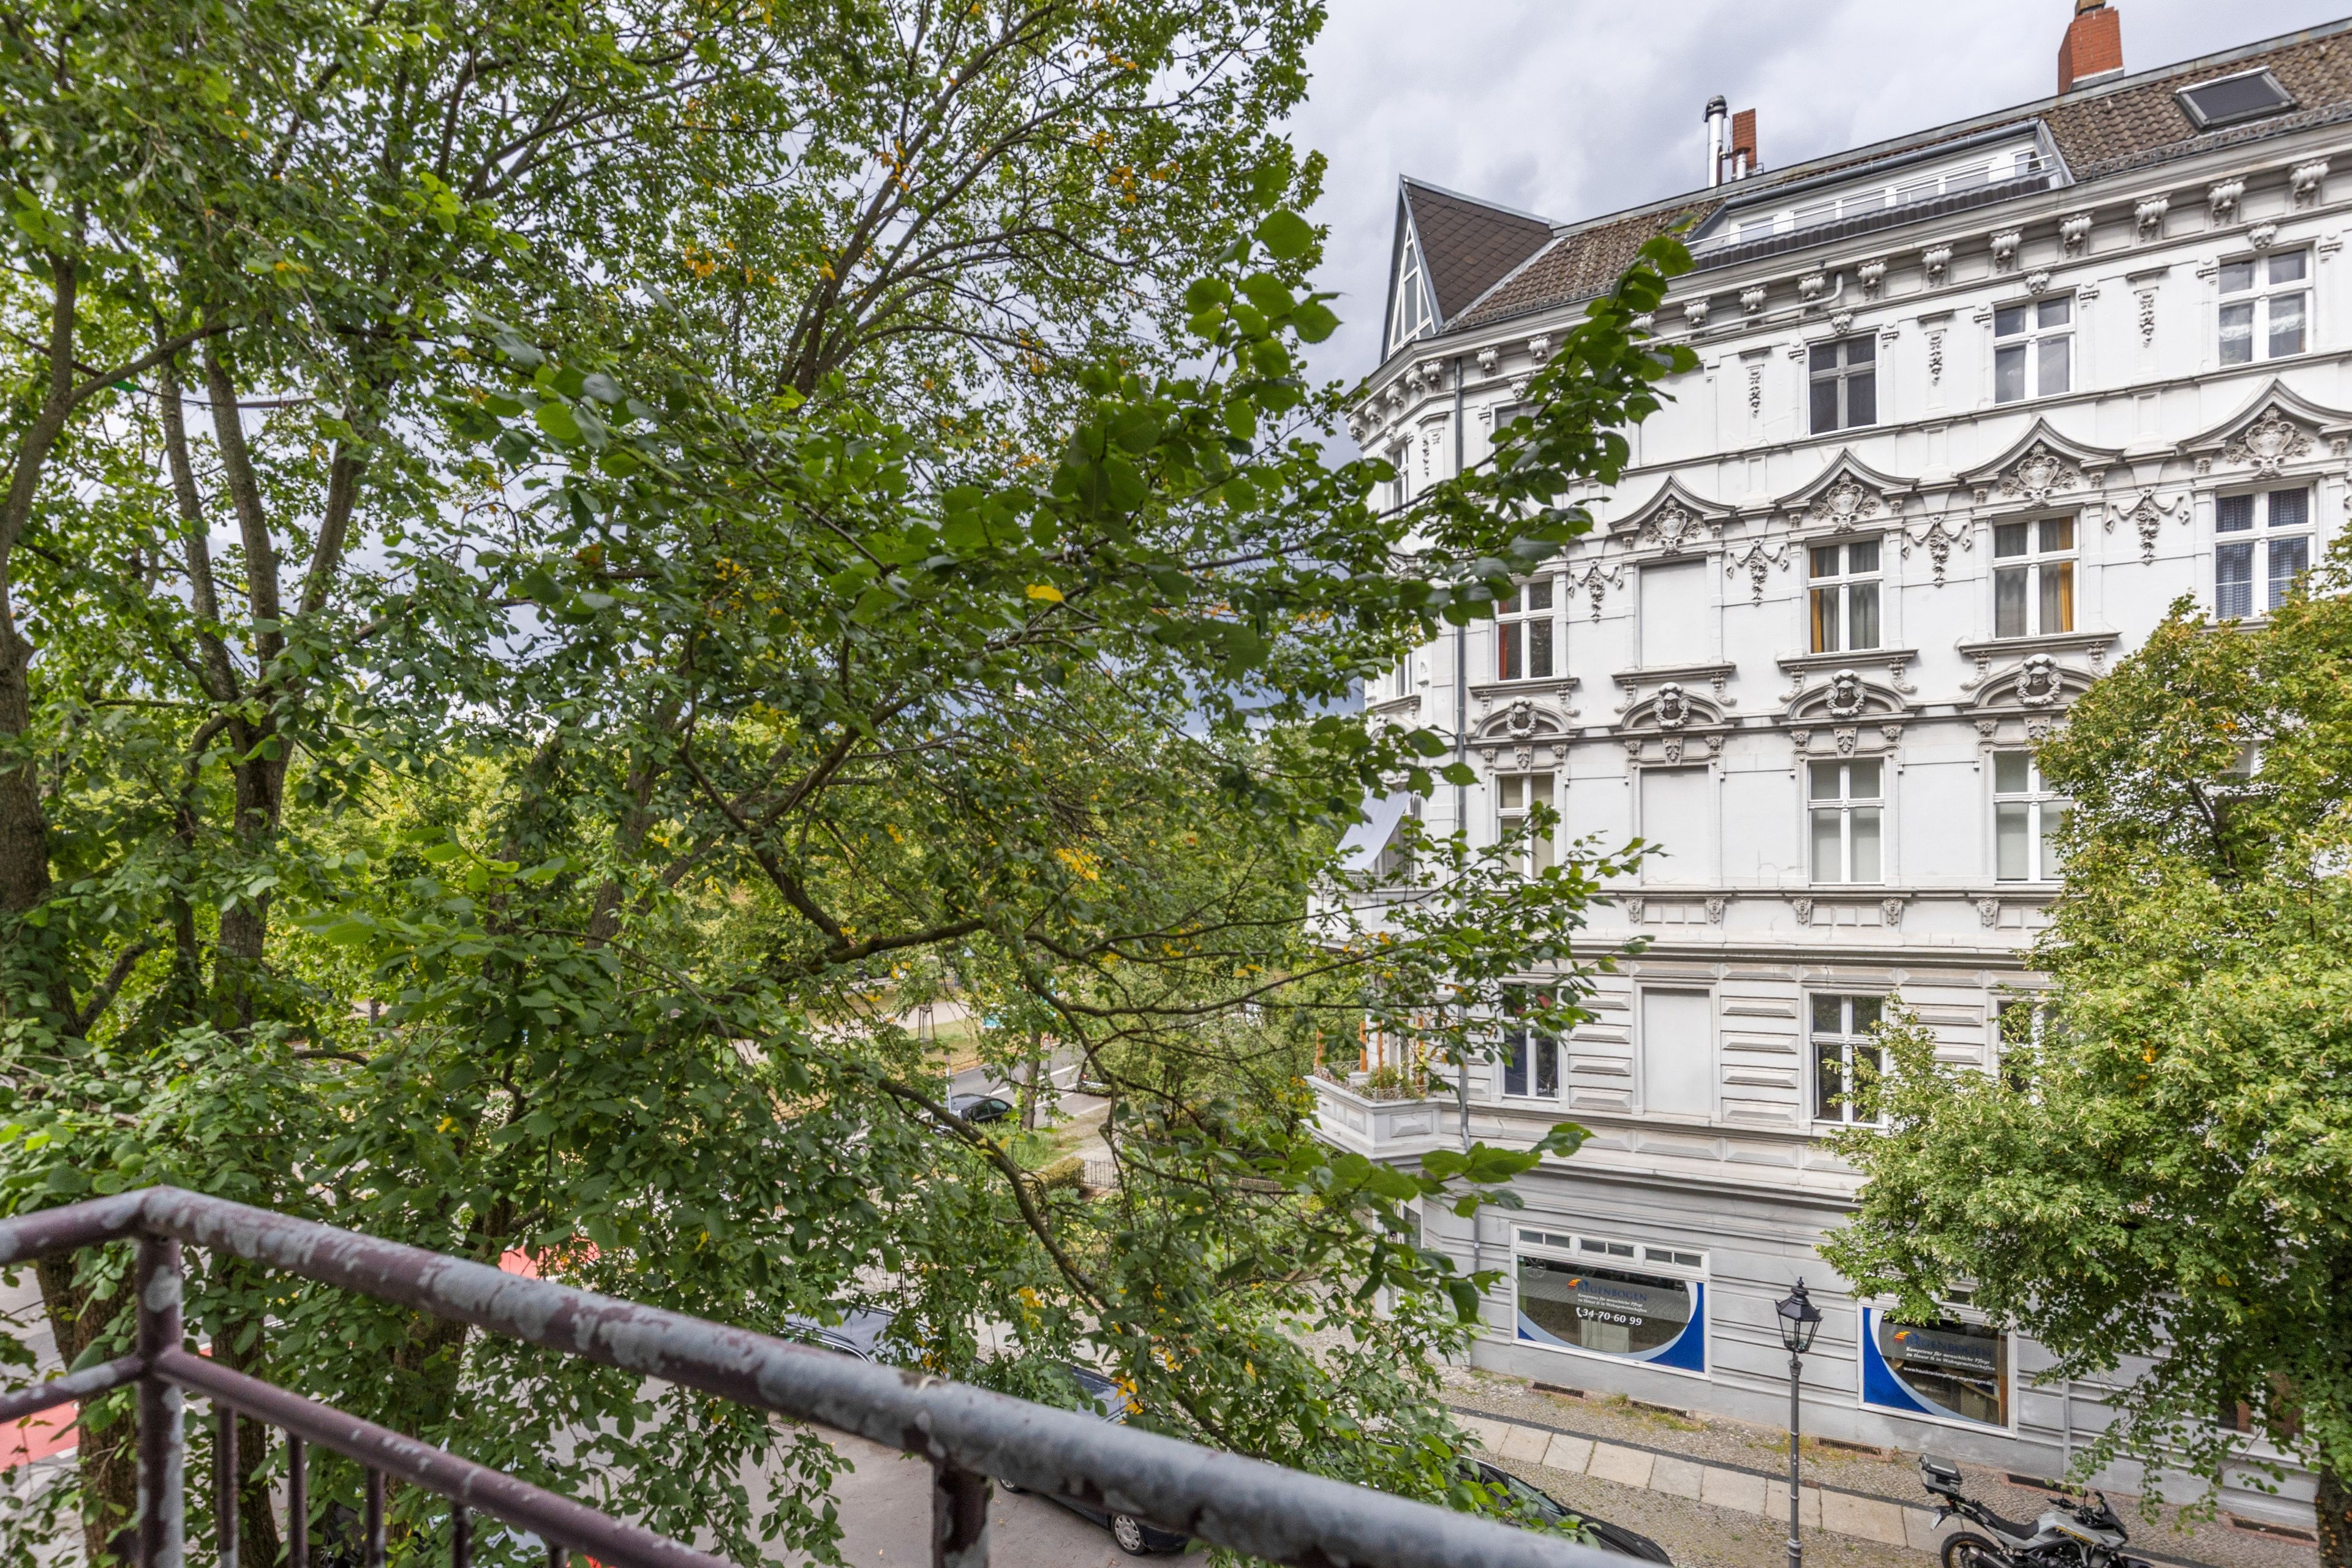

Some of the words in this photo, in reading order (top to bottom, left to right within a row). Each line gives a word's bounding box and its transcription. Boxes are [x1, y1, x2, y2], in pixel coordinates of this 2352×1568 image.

[1578, 1280, 1648, 1302] REGENBOGEN
[1606, 1302, 1647, 1313] Wohngemeinschaften
[1582, 1308, 1594, 1317] 34
[1598, 1311, 1610, 1320] 70
[1613, 1314, 1626, 1323] 60
[1629, 1317, 1642, 1325] 99
[1943, 1358, 1996, 1371] Wohngemeinschaften
